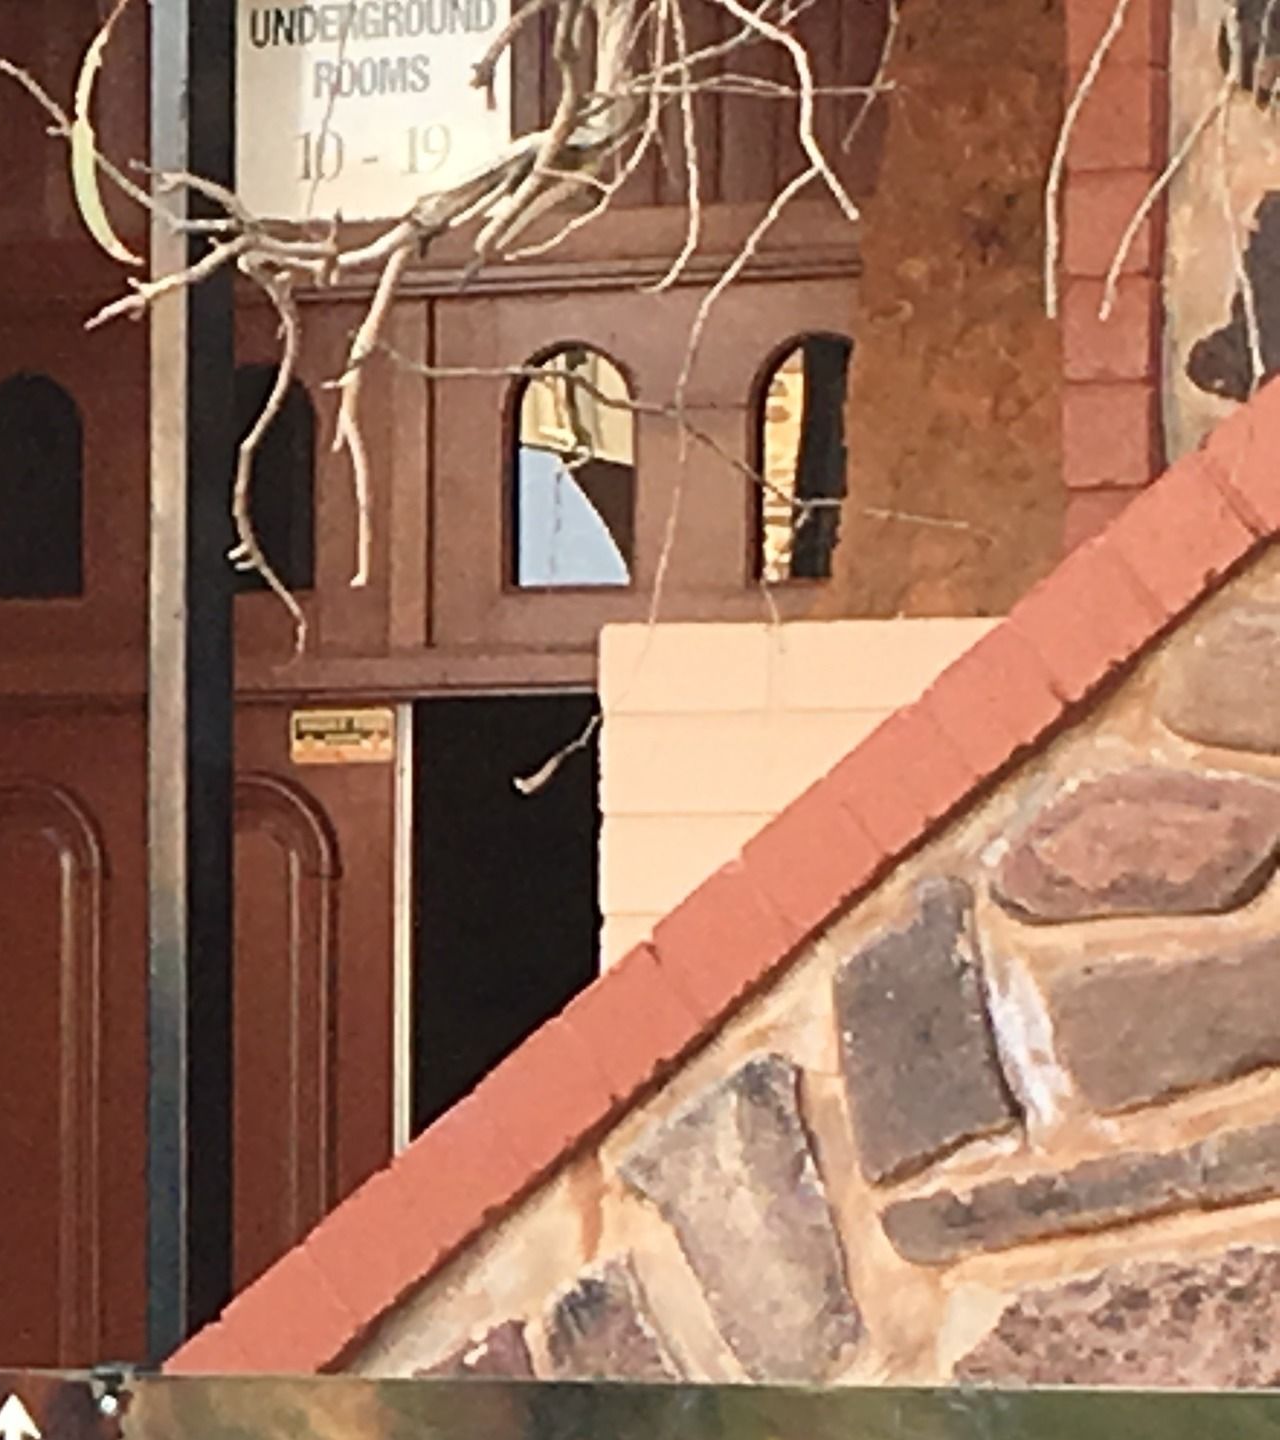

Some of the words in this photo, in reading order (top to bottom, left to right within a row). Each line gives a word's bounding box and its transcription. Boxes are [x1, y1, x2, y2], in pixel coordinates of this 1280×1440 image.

[312, 54, 431, 99] ROOMS
[294, 130, 345, 182] 10
[399, 123, 452, 176] 19
